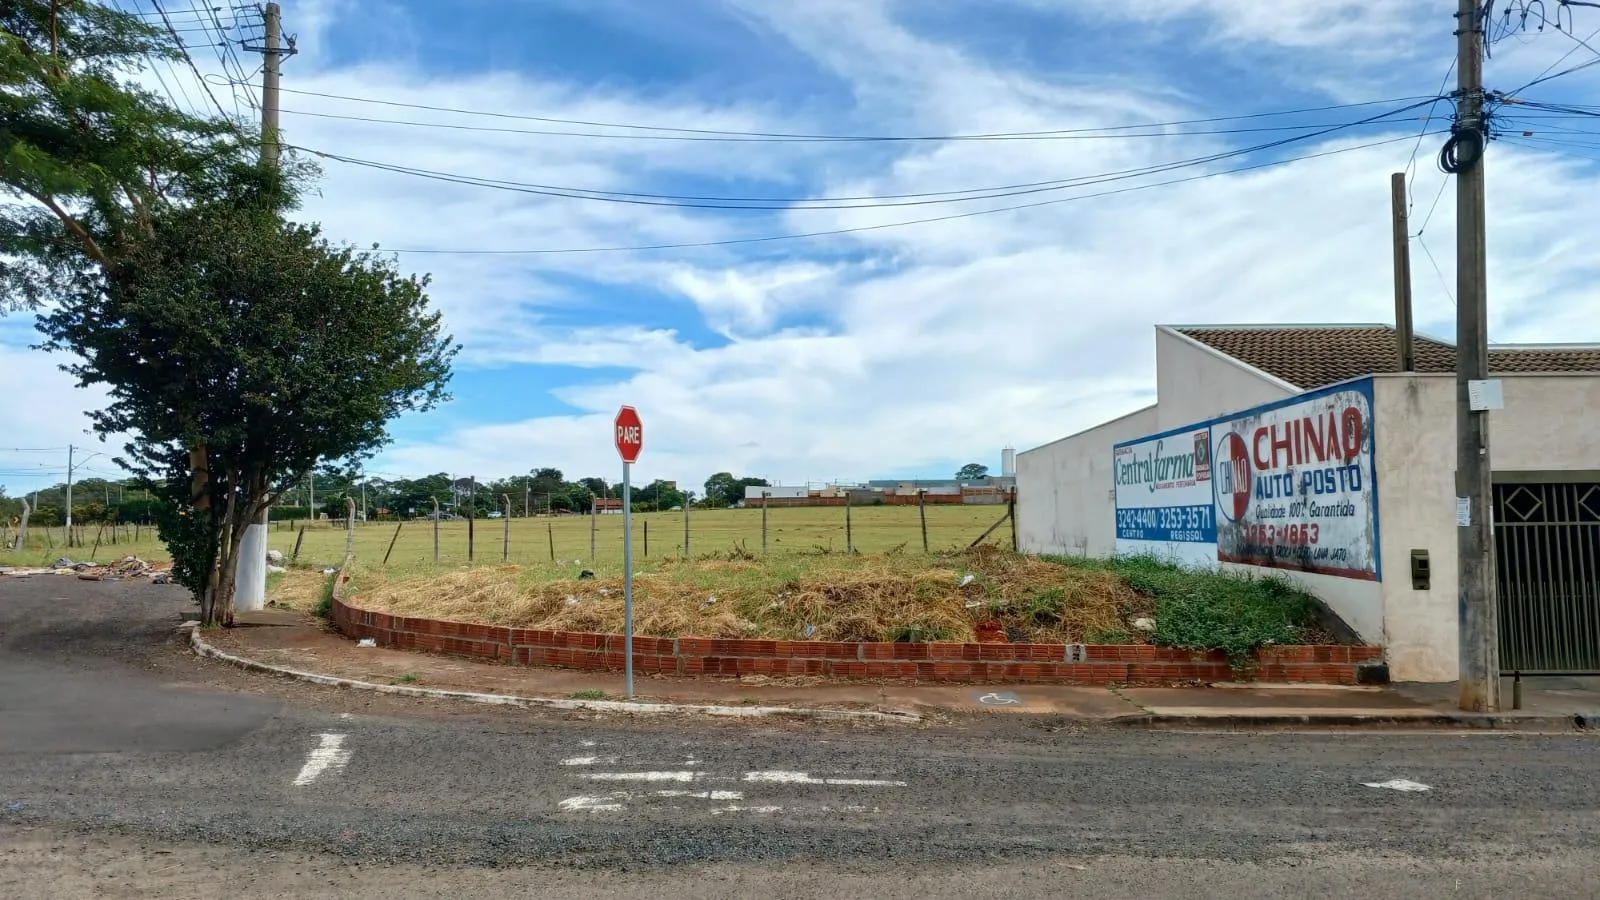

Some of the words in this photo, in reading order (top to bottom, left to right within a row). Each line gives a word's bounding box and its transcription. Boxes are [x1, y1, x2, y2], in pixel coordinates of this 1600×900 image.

[618, 426, 640, 444] PARE
[1253, 405, 1363, 471] CHINÃO
[1220, 456, 1248, 495] CHINÃO
[1256, 472, 1294, 500] AUTO
[1302, 464, 1362, 495] POSTO
[1160, 506, 1211, 529] 3253-3571
[1256, 503, 1286, 519] Qualidade
[1310, 500, 1355, 518] Garantida
[1170, 530, 1204, 541] REGISSOL
